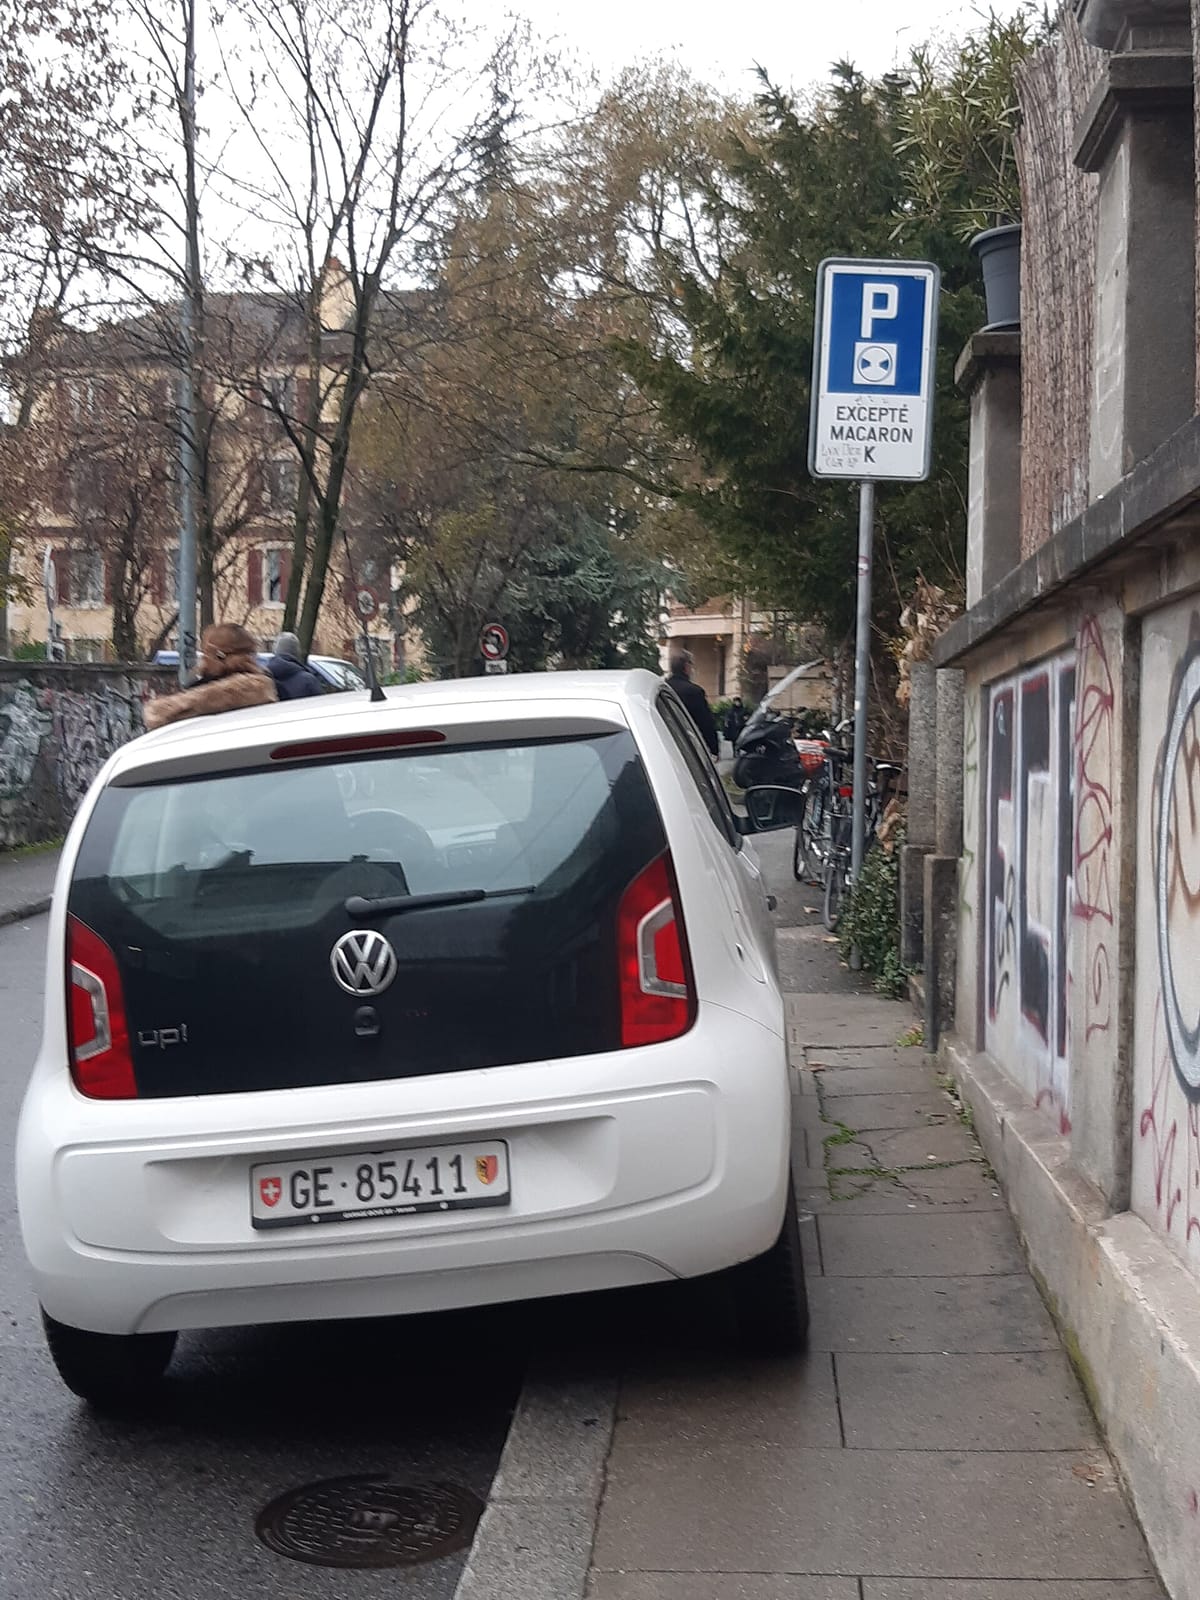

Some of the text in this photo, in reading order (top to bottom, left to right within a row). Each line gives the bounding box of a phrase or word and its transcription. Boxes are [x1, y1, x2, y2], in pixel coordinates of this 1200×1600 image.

[861, 283, 899, 338] P
[830, 425, 913, 443] MACARON
[864, 446, 876, 463] K
